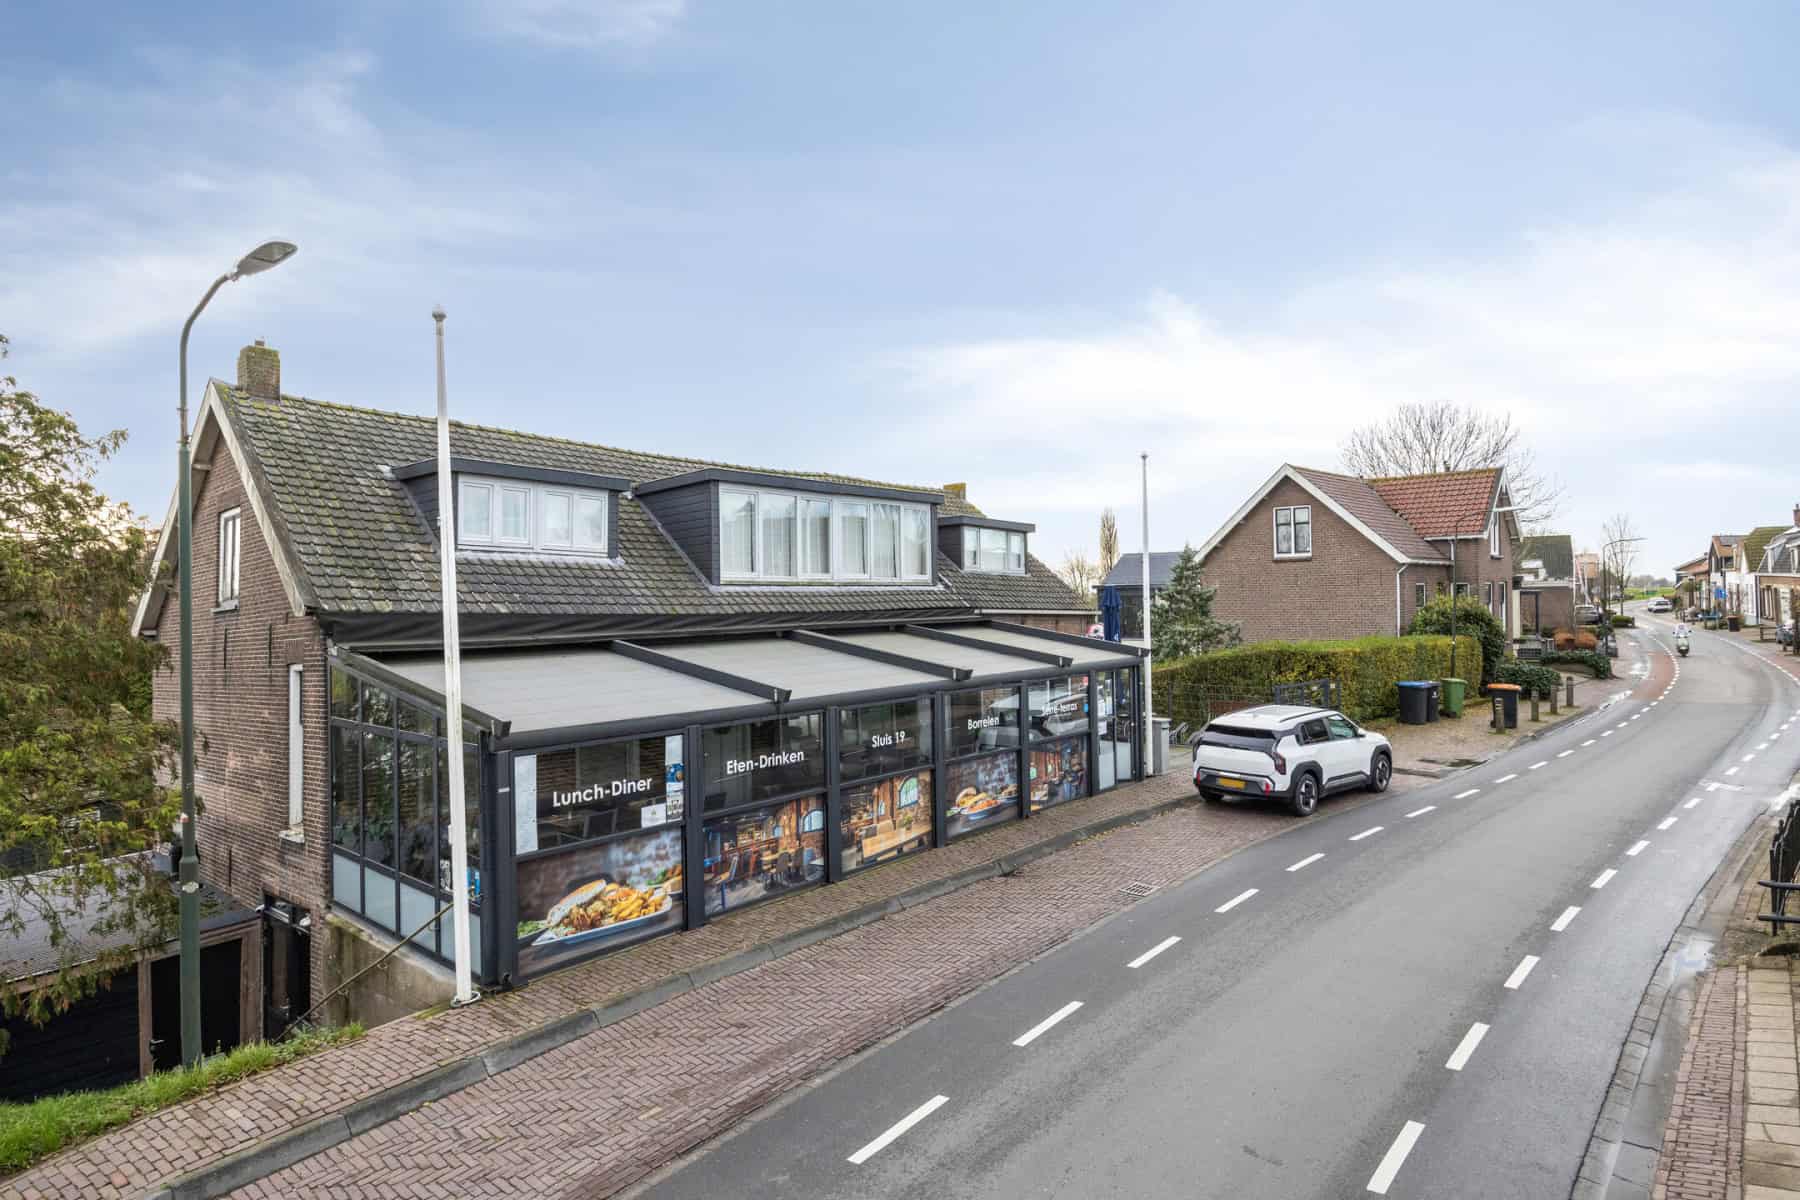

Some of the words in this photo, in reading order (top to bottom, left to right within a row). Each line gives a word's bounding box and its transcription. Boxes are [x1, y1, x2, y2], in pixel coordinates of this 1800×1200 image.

[967, 716, 1000, 730] Borrelen
[871, 732, 892, 748] Sluis
[896, 730, 906, 745] 19
[726, 750, 804, 775] Eten-Drinken
[553, 777, 652, 807] Lunch-Diner
